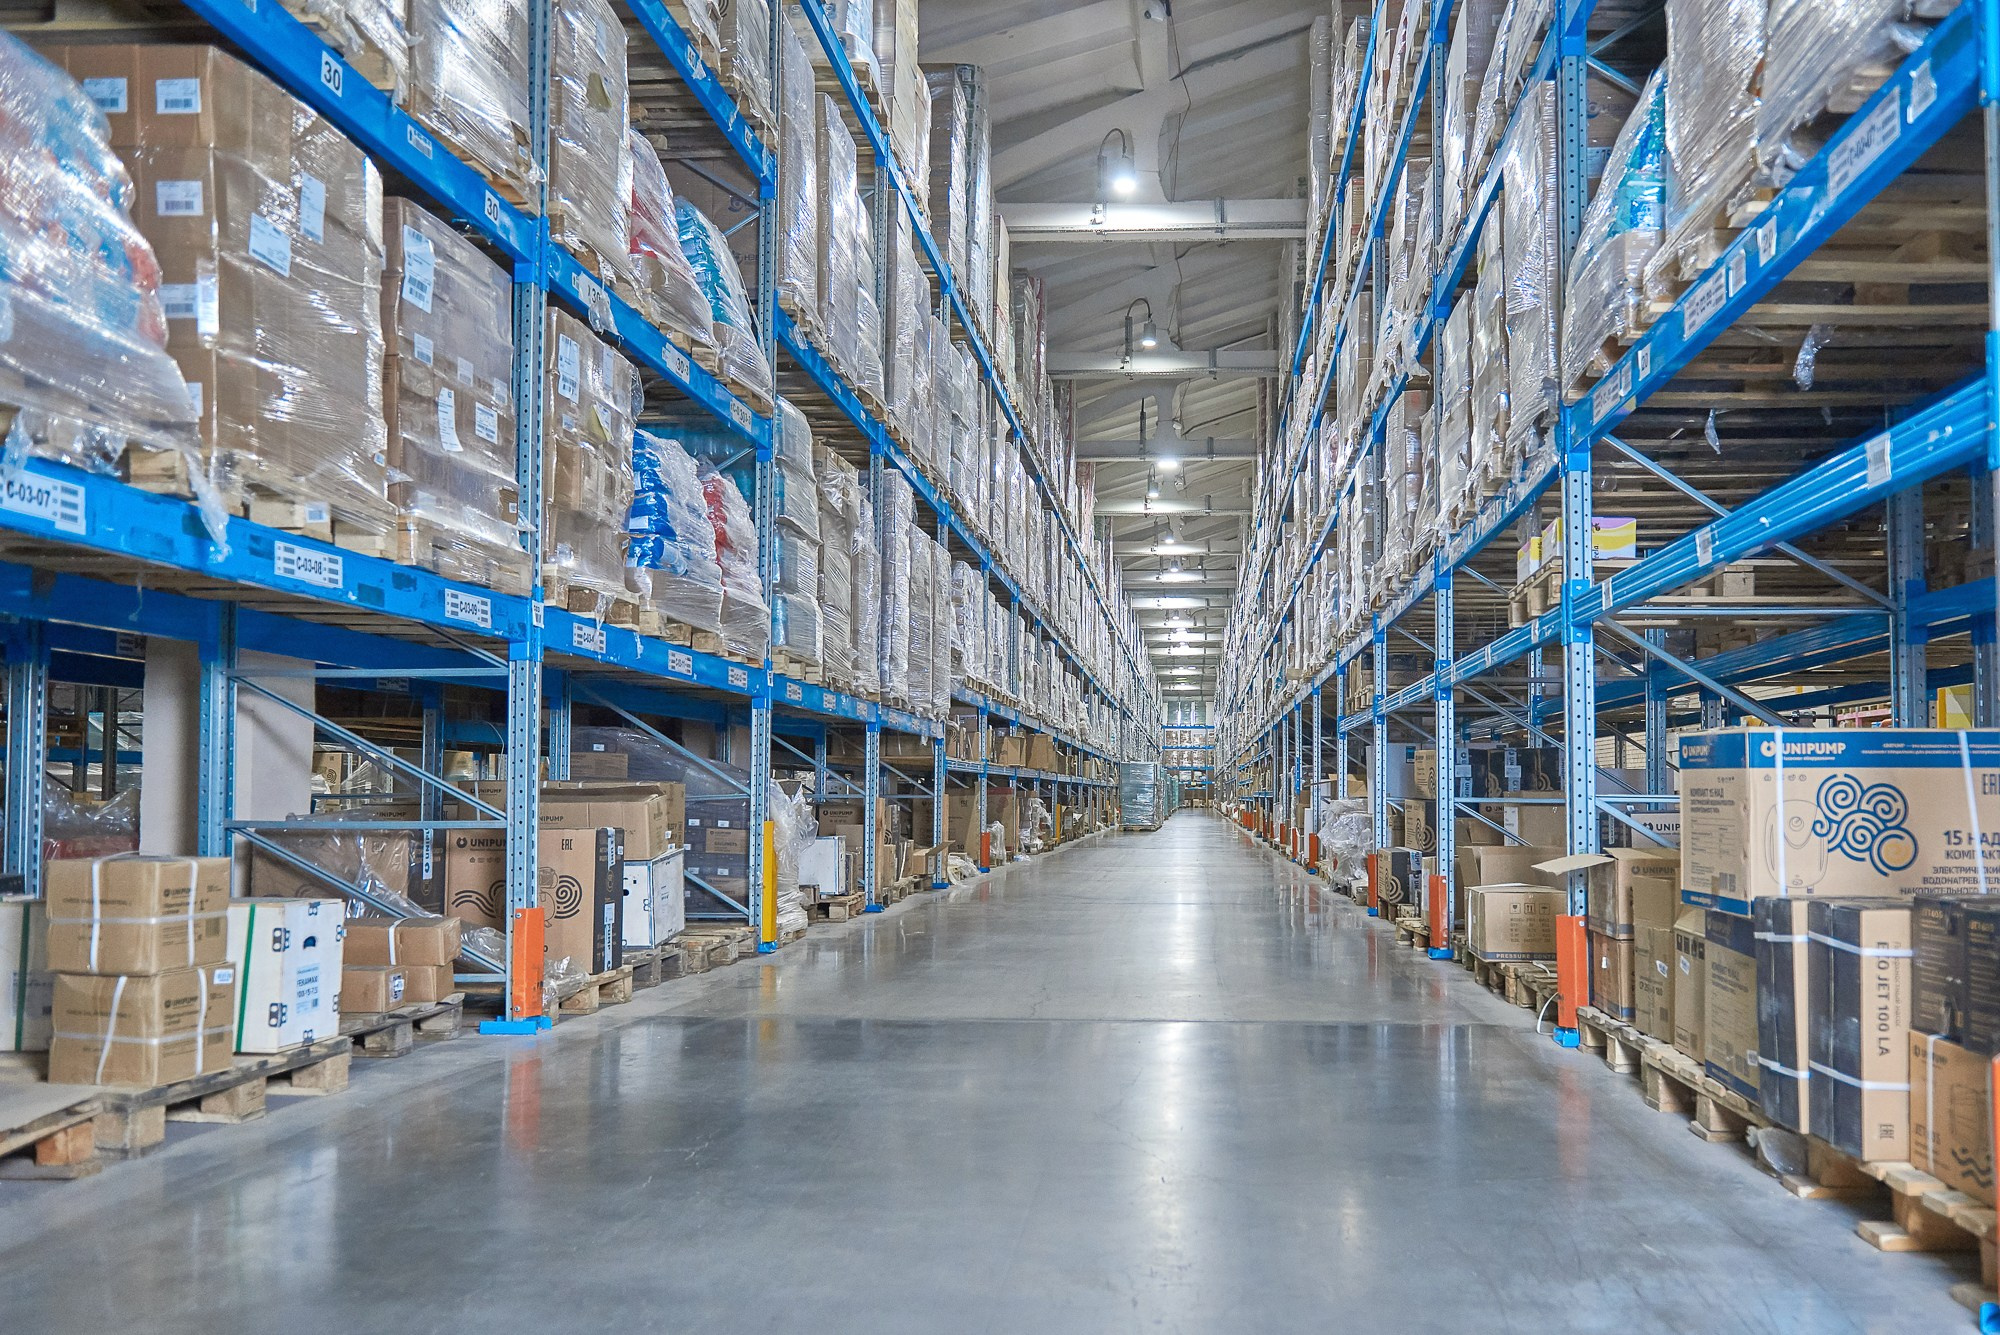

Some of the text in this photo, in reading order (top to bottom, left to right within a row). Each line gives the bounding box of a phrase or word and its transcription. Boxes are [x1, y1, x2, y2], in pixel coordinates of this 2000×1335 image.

[323, 61, 341, 92] 30
[486, 199, 499, 221] 30
[6, 479, 51, 509] C-03-07
[296, 557, 322, 575] C-03-08
[459, 601, 478, 616] C-03-09
[1783, 742, 1847, 755] UNIPUMP
[561, 838, 573, 850] EAC
[1944, 830, 1963, 846] 15
[1876, 941, 1891, 1057] EO JET 100 LA
